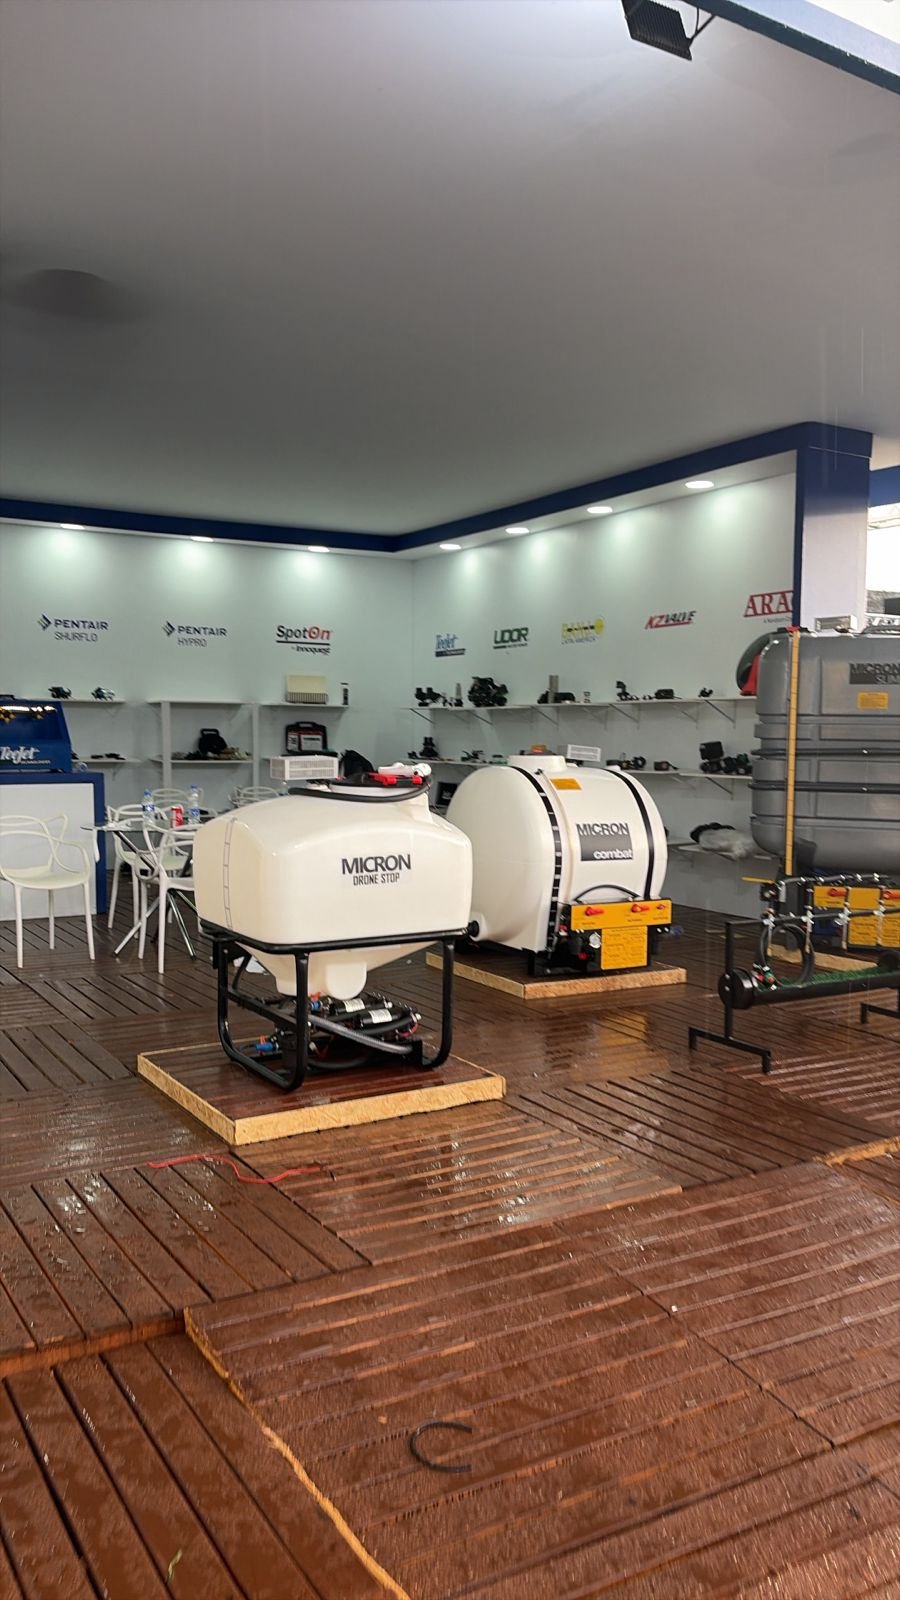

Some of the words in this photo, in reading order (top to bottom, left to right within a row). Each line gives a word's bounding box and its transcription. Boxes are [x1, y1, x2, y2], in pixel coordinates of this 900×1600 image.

[743, 589, 794, 618] ARA
[54, 618, 109, 630] PENTAIR
[177, 625, 228, 637] PENTAIR
[493, 627, 529, 644] UDOR
[576, 822, 630, 836] MICRON
[593, 848, 634, 860] combat
[341, 853, 411, 875] MICRON
[352, 874, 379, 886] DRONE
[380, 872, 400, 884] STOP
